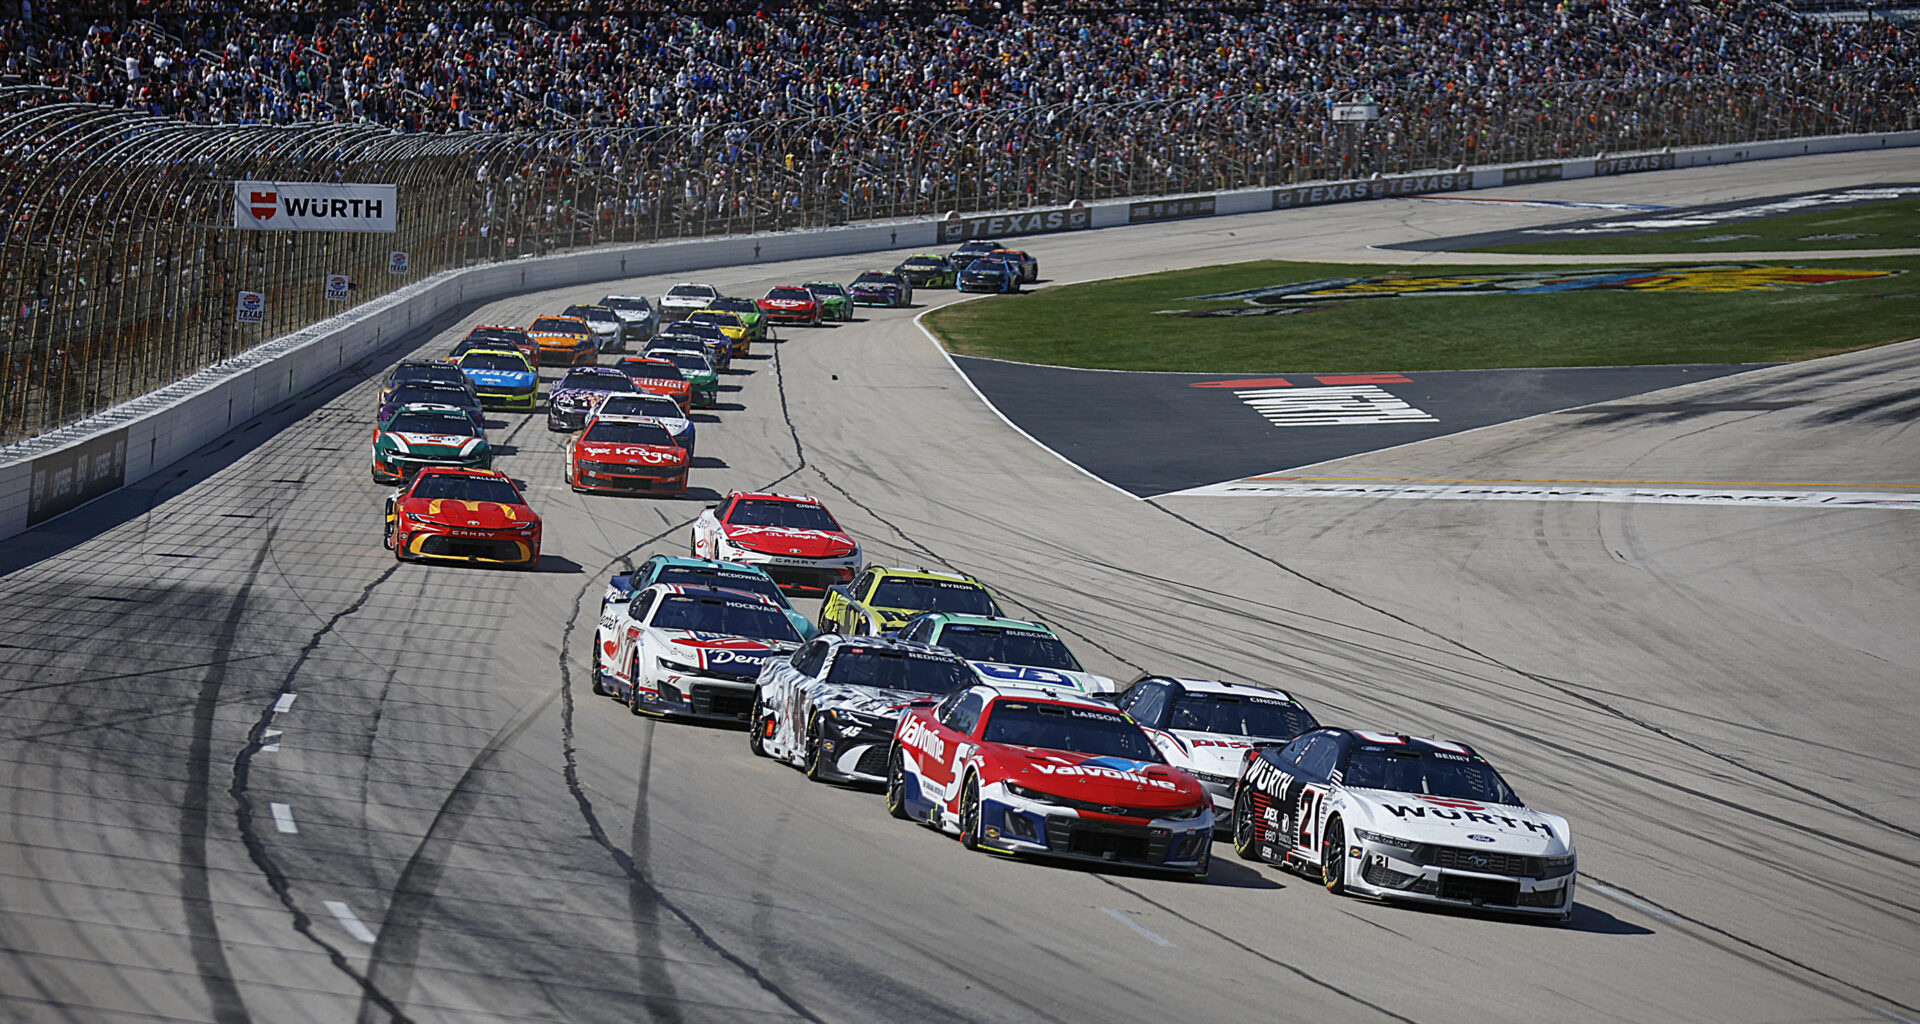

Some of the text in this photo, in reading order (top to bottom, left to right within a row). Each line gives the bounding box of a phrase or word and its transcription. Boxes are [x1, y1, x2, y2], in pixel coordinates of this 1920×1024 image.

[1608, 156, 1660, 172] TEXAS
[1297, 183, 1368, 201] TEXAS
[1389, 175, 1453, 193] TEXAS
[284, 197, 382, 218] WÜRTH
[969, 211, 1064, 236] TEXAS
[327, 289, 347, 297] TEXAS
[239, 309, 263, 319] TEXAS
[616, 447, 681, 463] Kroger
[775, 557, 818, 565] CAMRY
[940, 582, 973, 591] BYRON
[726, 601, 779, 613] HOCEVAR
[1005, 630, 1054, 640] BUESCHE
[908, 652, 956, 663] REDDICK
[1250, 697, 1291, 708] CINDRIC
[1071, 709, 1122, 723] LARSON
[841, 725, 863, 738] 45
[899, 711, 945, 763] Valvoline
[1434, 751, 1471, 763] BERRY
[944, 742, 972, 802] 5
[1031, 763, 1176, 791] Valvoline
[1246, 756, 1295, 801] WÜRTH
[1263, 806, 1279, 822] DEX
[1300, 788, 1324, 852] 21
[1382, 803, 1554, 838] WÜRTH
[1375, 855, 1390, 868] 21
